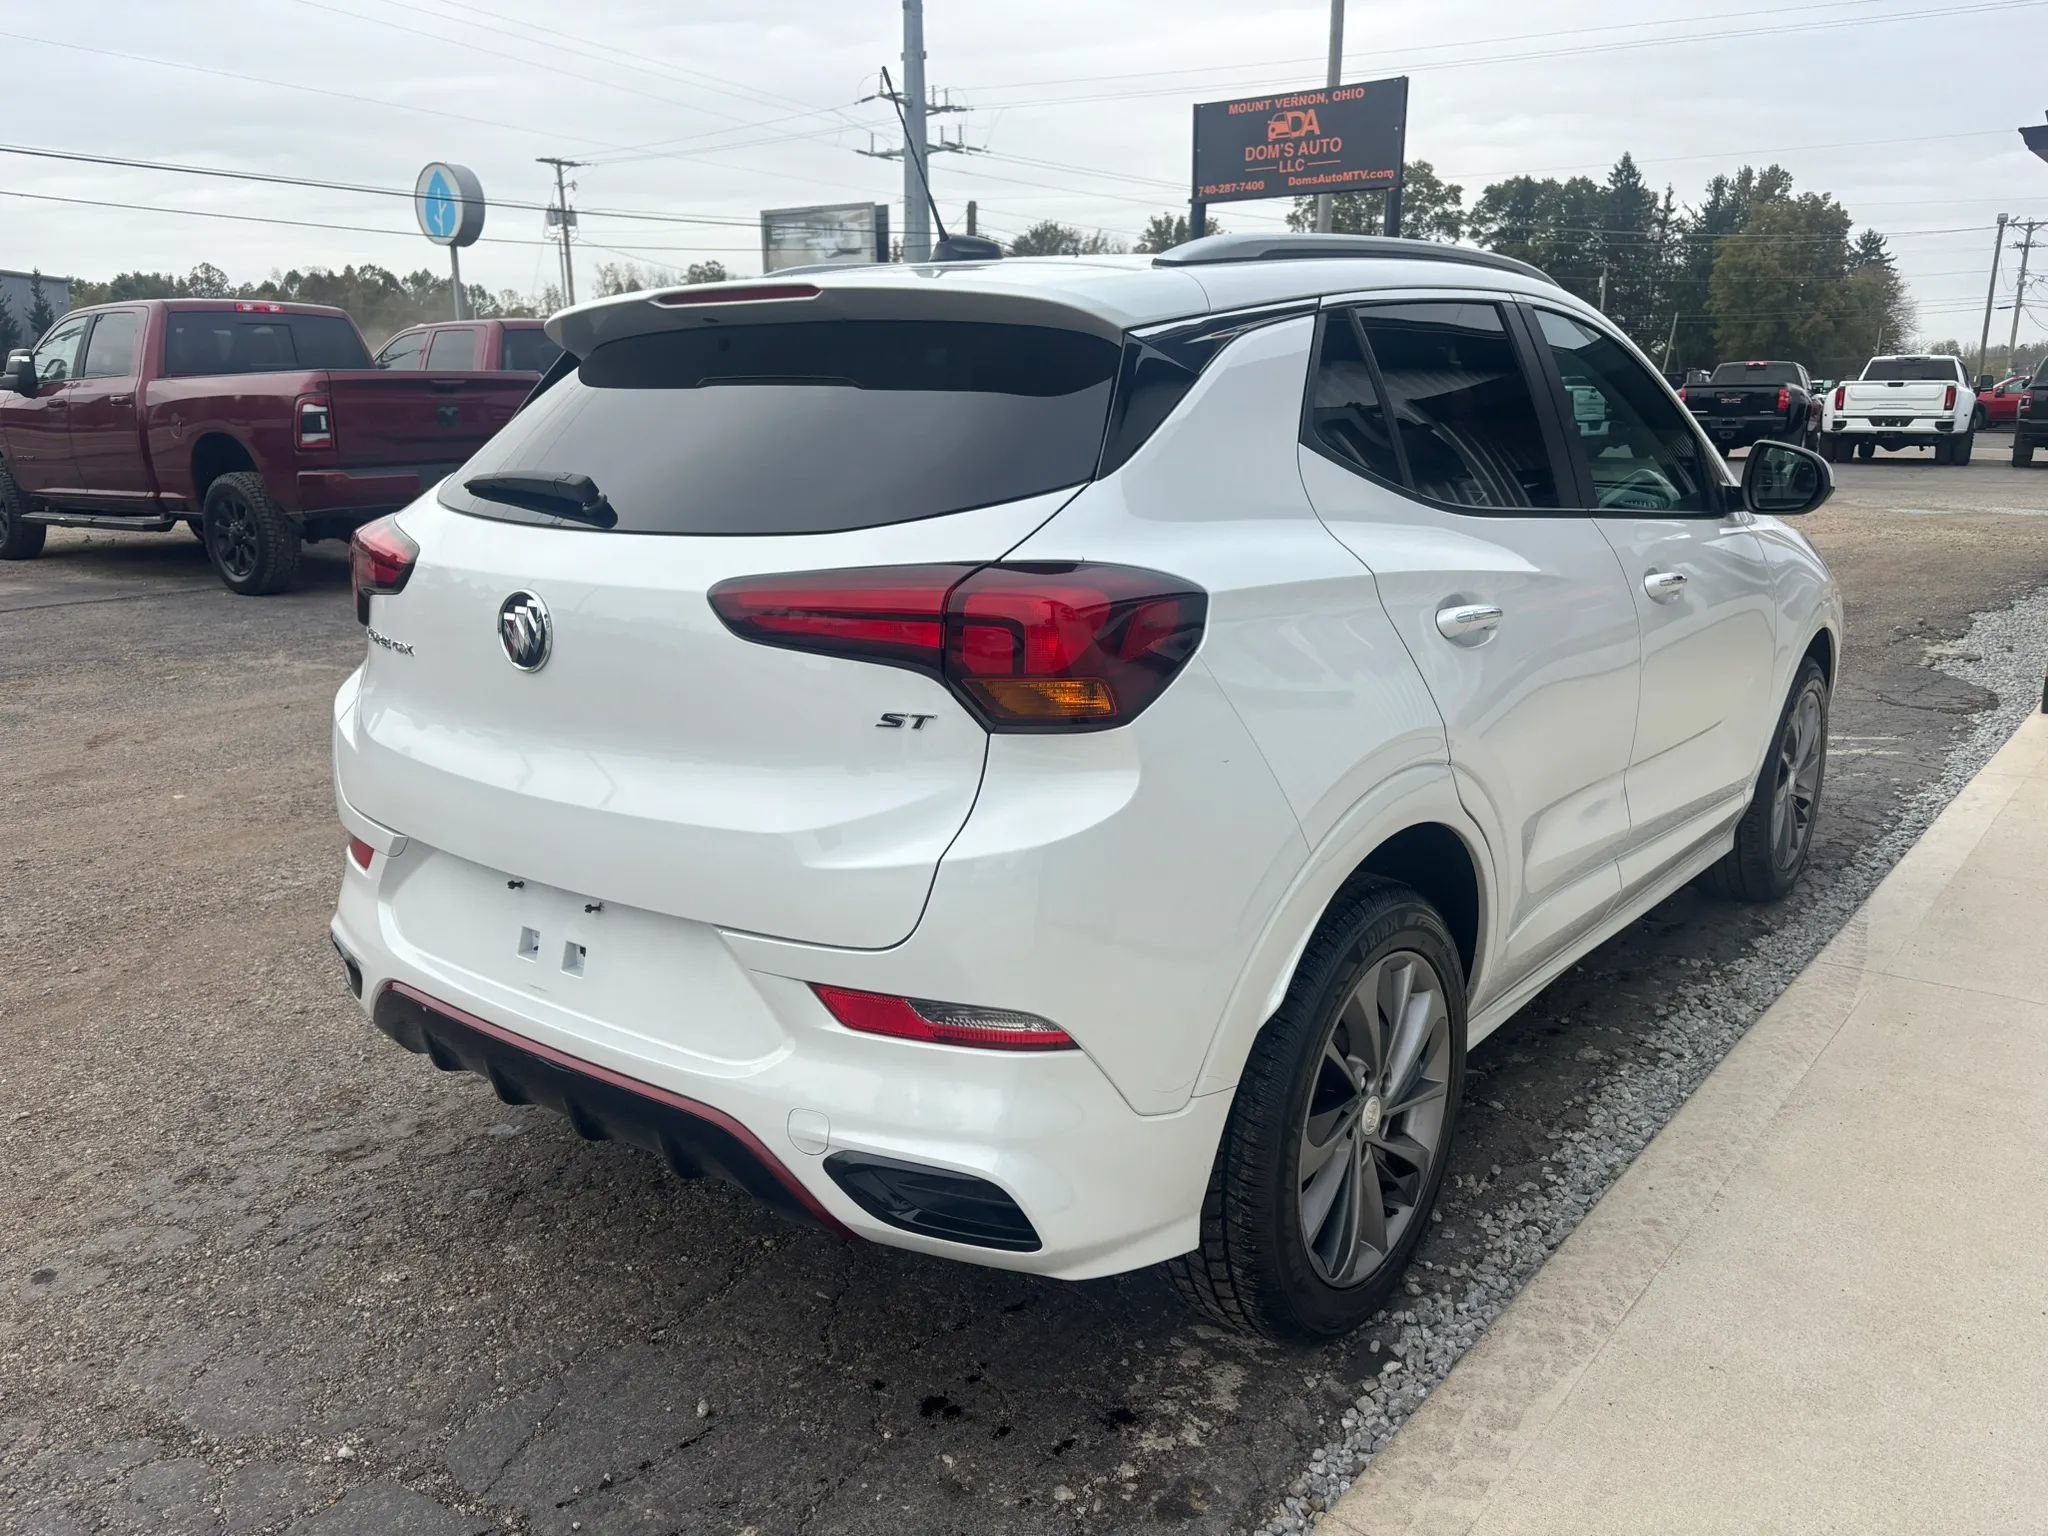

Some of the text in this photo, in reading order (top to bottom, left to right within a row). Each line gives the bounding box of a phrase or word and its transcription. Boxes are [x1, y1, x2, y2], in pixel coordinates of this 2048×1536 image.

[1228, 87, 1366, 115] MOUNT VERNON, OHIO
[1244, 137, 1343, 161] DOM'S AUTO
[1278, 159, 1305, 174] LLC
[1287, 169, 1395, 186] DomsAutoMTV.com
[1198, 180, 1265, 197] 740-287-7400
[875, 712, 938, 730] ST
